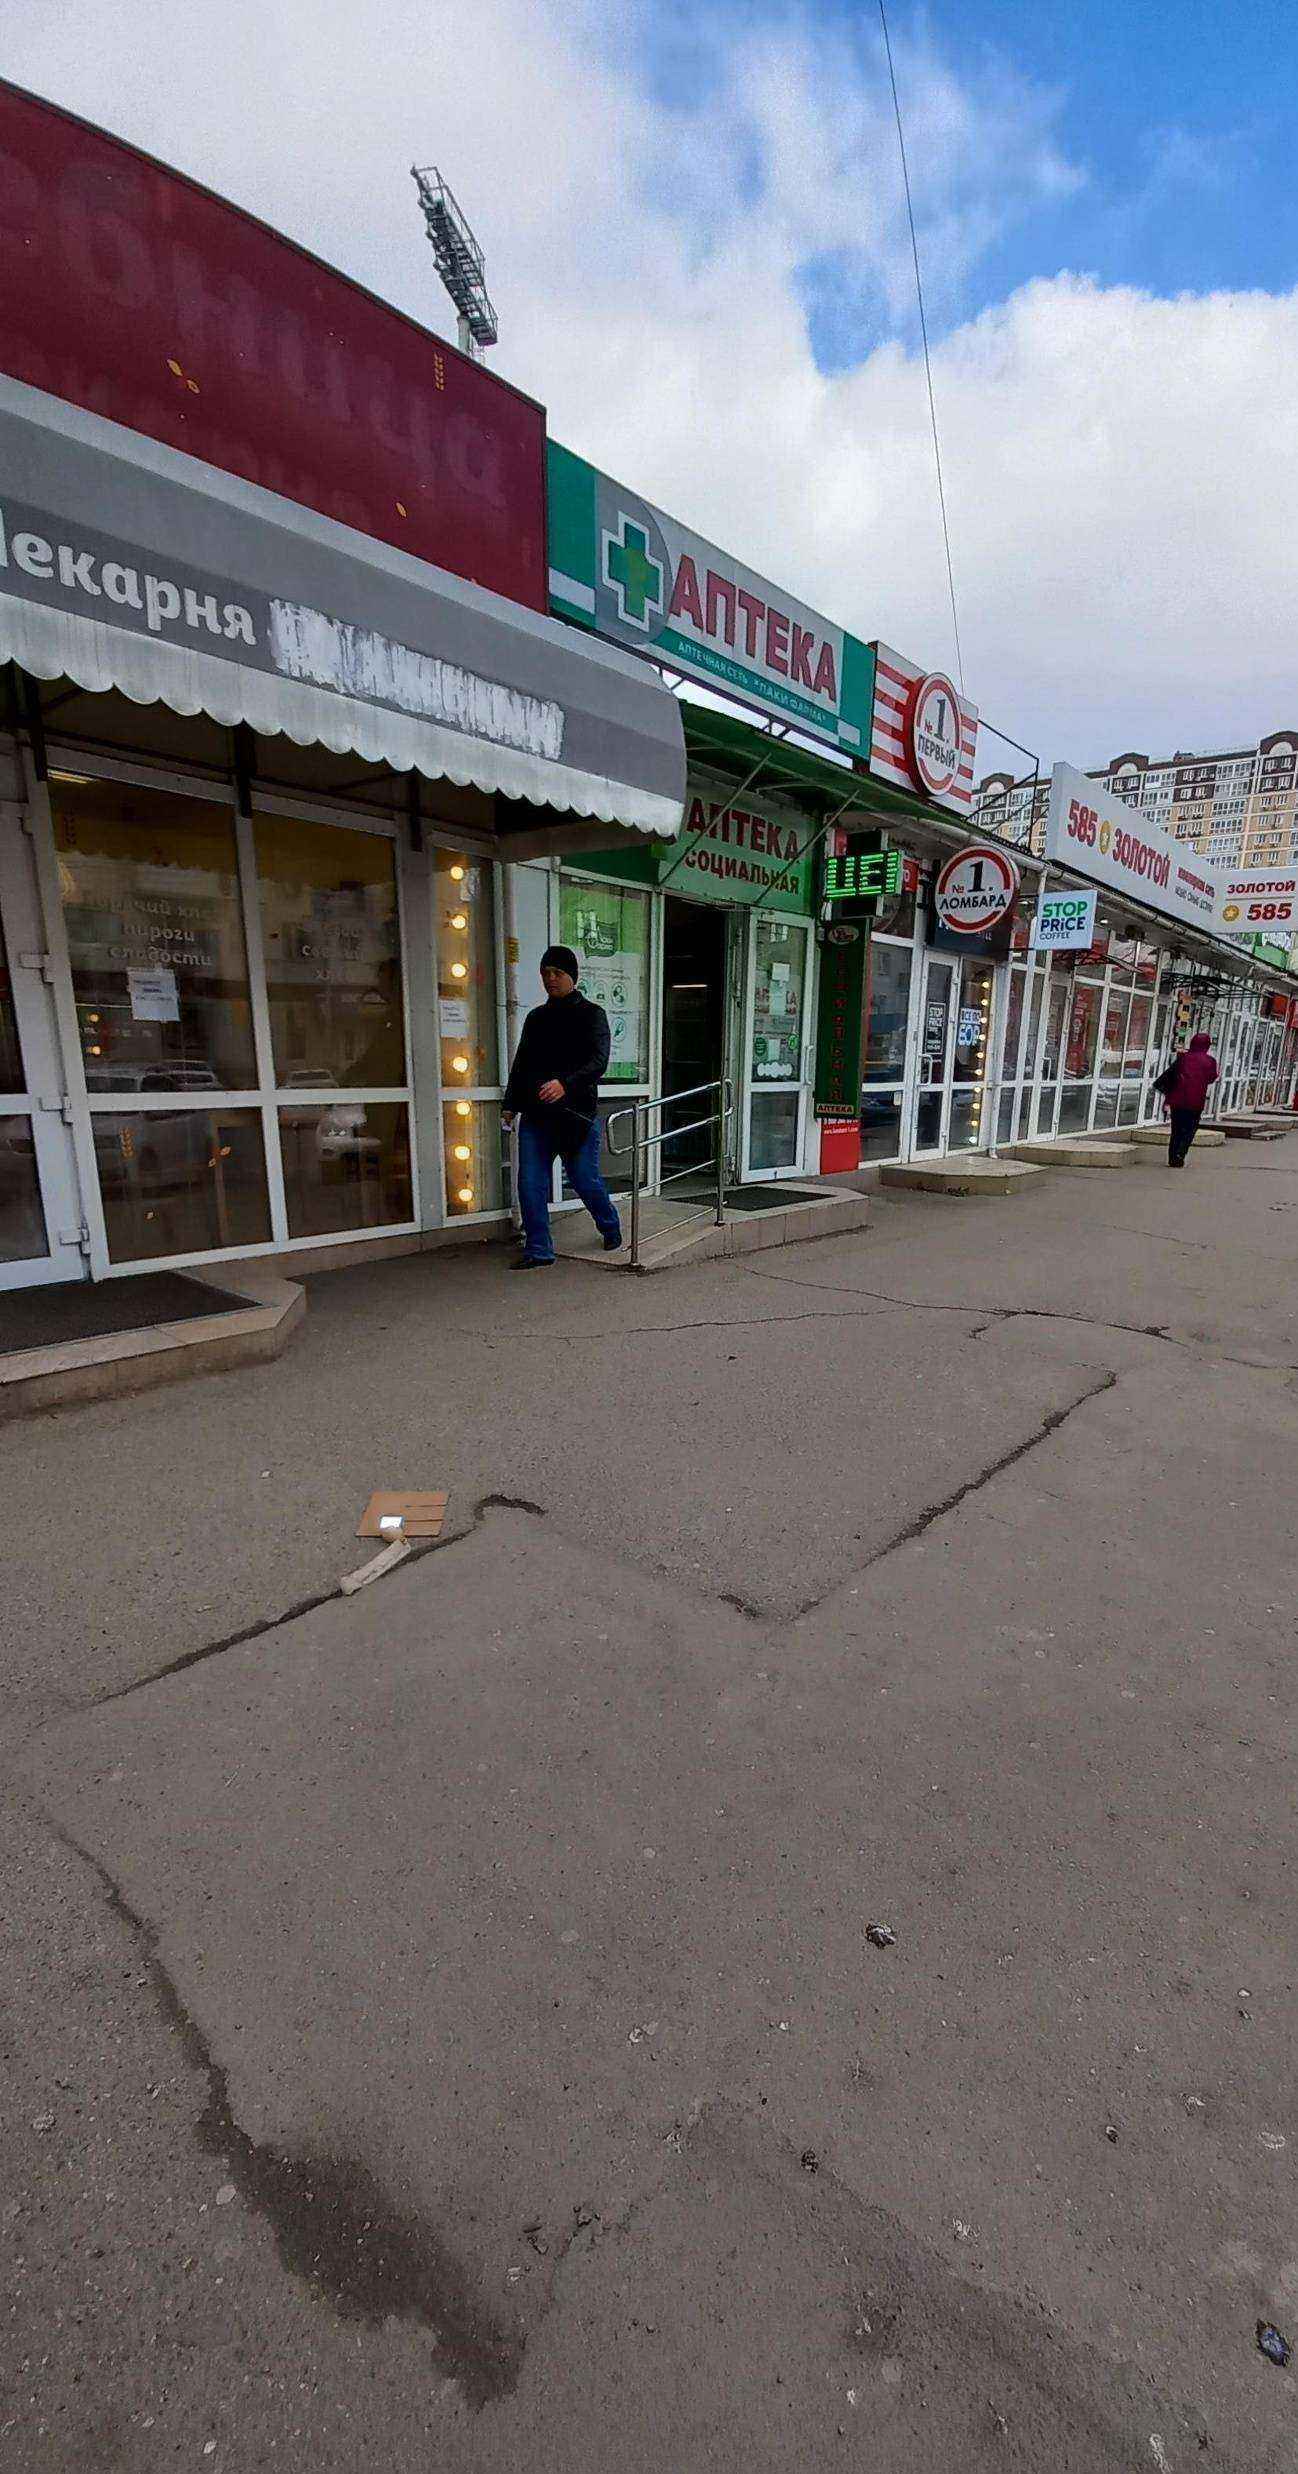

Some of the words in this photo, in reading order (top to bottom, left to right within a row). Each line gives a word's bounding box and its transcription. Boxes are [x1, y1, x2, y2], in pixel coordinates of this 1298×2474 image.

[0, 505, 256, 646] екарня
[669, 553, 837, 703] АПТЕКА
[917, 733, 957, 771] ПЕРВЫЙ
[686, 797, 799, 862] АПТЕКА
[1067, 798, 1099, 848] 585
[1112, 827, 1172, 890] ЗОЛОТОЙ
[683, 849, 800, 896] СОЦИАЛЬНАЯ
[1227, 879, 1296, 895] ЗОЛОТОЙ
[939, 894, 1007, 911] ЛОМБАРД
[1042, 900, 1088, 918] STOP
[1246, 902, 1292, 921] 585
[1039, 932, 1071, 941] COFFEE
[818, 1105, 853, 1113] АПТЕКА
